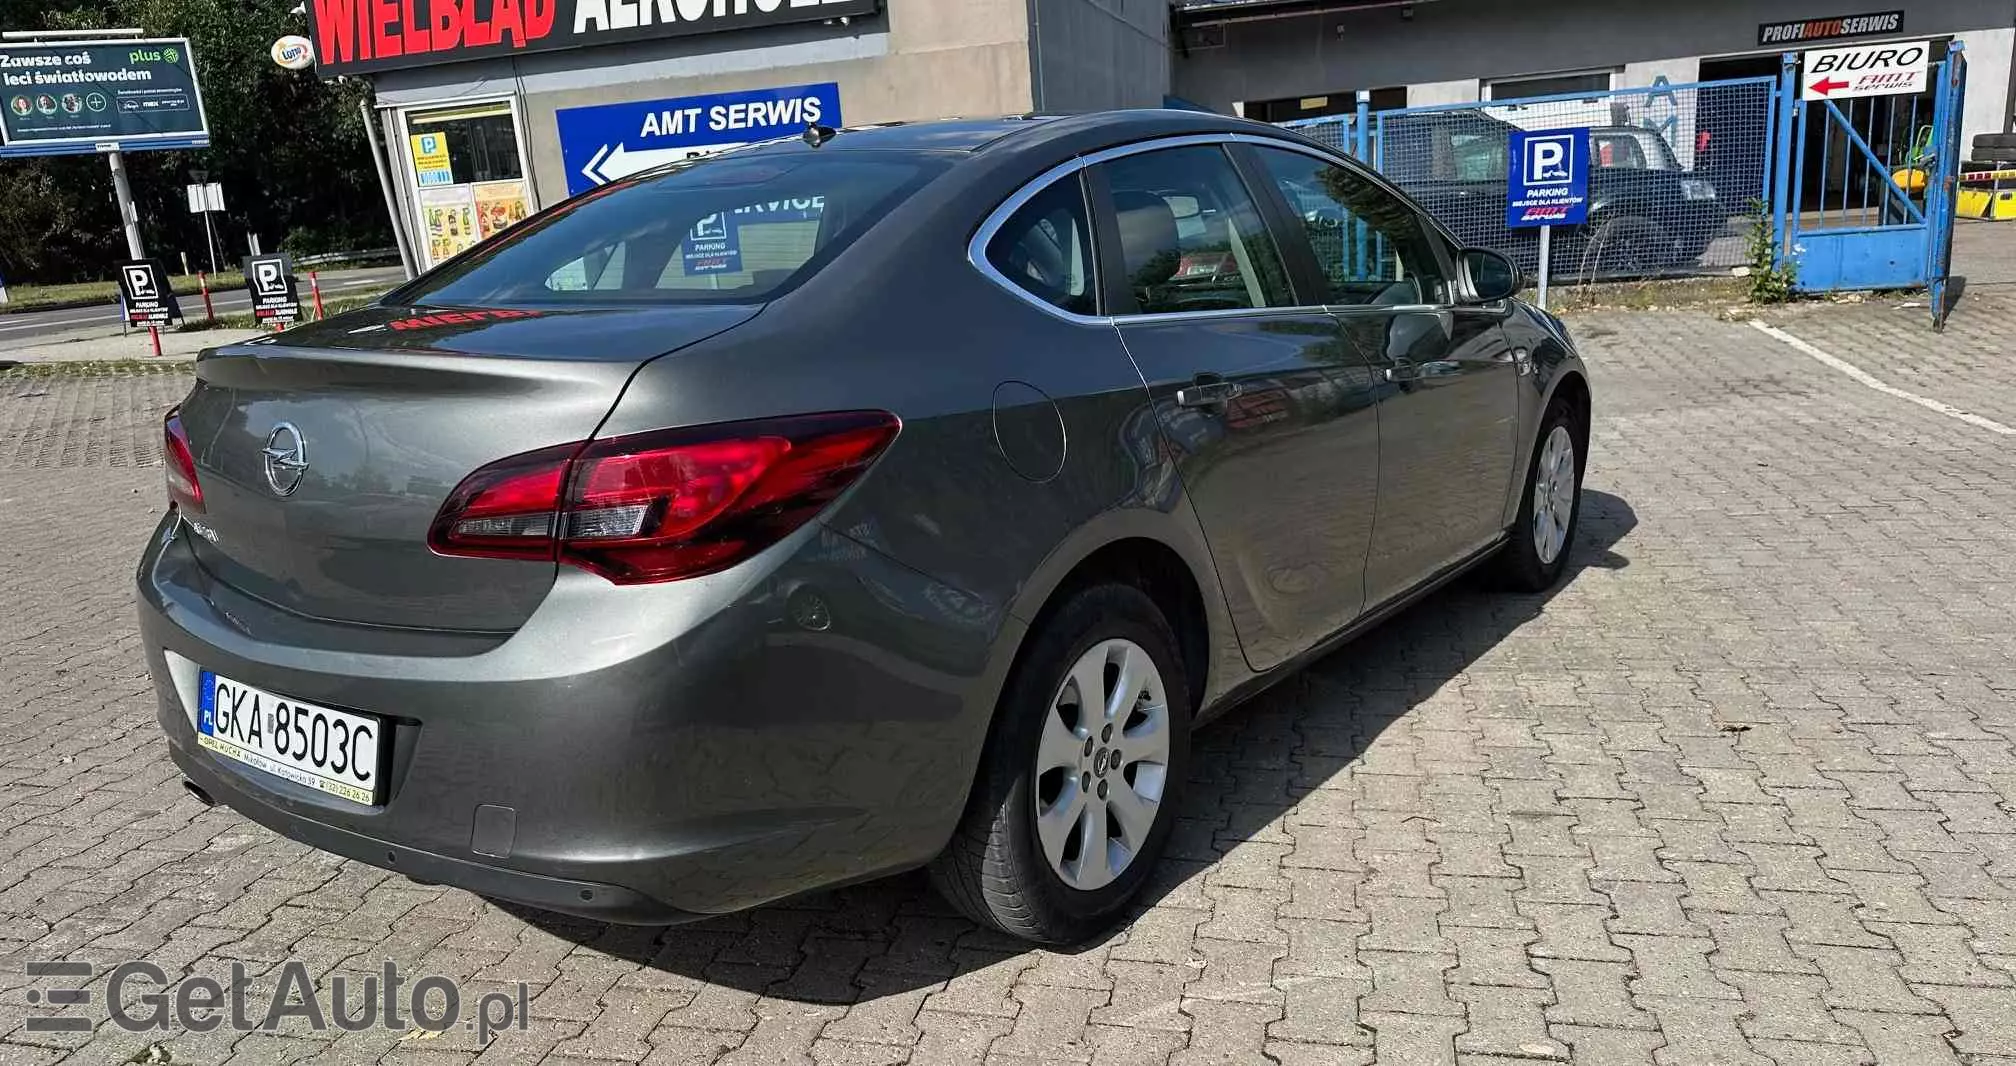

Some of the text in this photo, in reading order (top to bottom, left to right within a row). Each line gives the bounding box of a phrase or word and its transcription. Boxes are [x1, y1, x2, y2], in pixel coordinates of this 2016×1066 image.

[1762, 13, 1899, 42] PROFIAUTOSERWIS
[0, 51, 92, 68] Zawsze coś
[128, 48, 161, 65] plus
[1810, 47, 1924, 74] BIURO
[3, 68, 152, 86] leci światłowodem
[640, 96, 822, 138] AMT SERWIS
[1533, 142, 1563, 180] P
[1527, 187, 1569, 198] PARKING
[129, 270, 148, 296] P
[258, 264, 278, 291] P
[204, 711, 213, 726] PL
[215, 683, 373, 781] GKA 8503C
